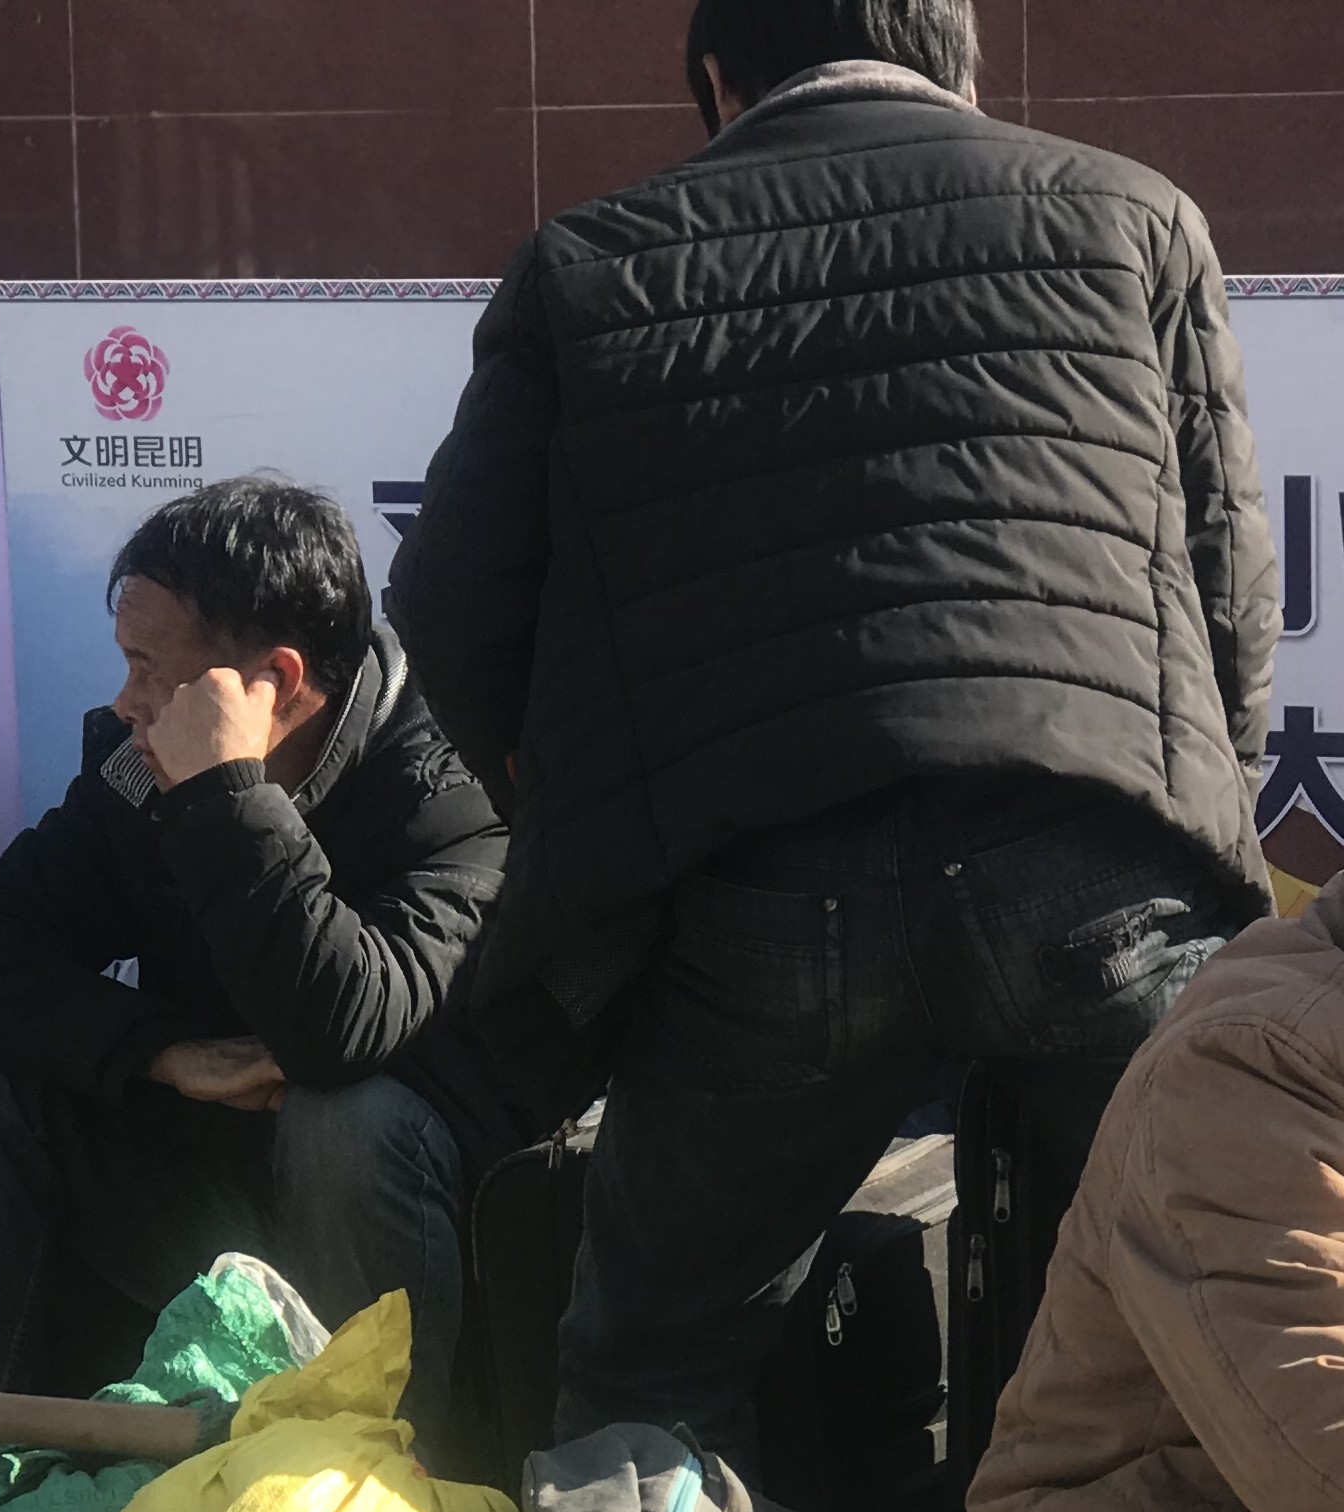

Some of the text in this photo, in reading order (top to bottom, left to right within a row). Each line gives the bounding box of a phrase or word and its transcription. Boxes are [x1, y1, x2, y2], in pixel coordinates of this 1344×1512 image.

[60, 435, 203, 468] 文明昆明
[61, 473, 203, 489] Civilized Kunming
